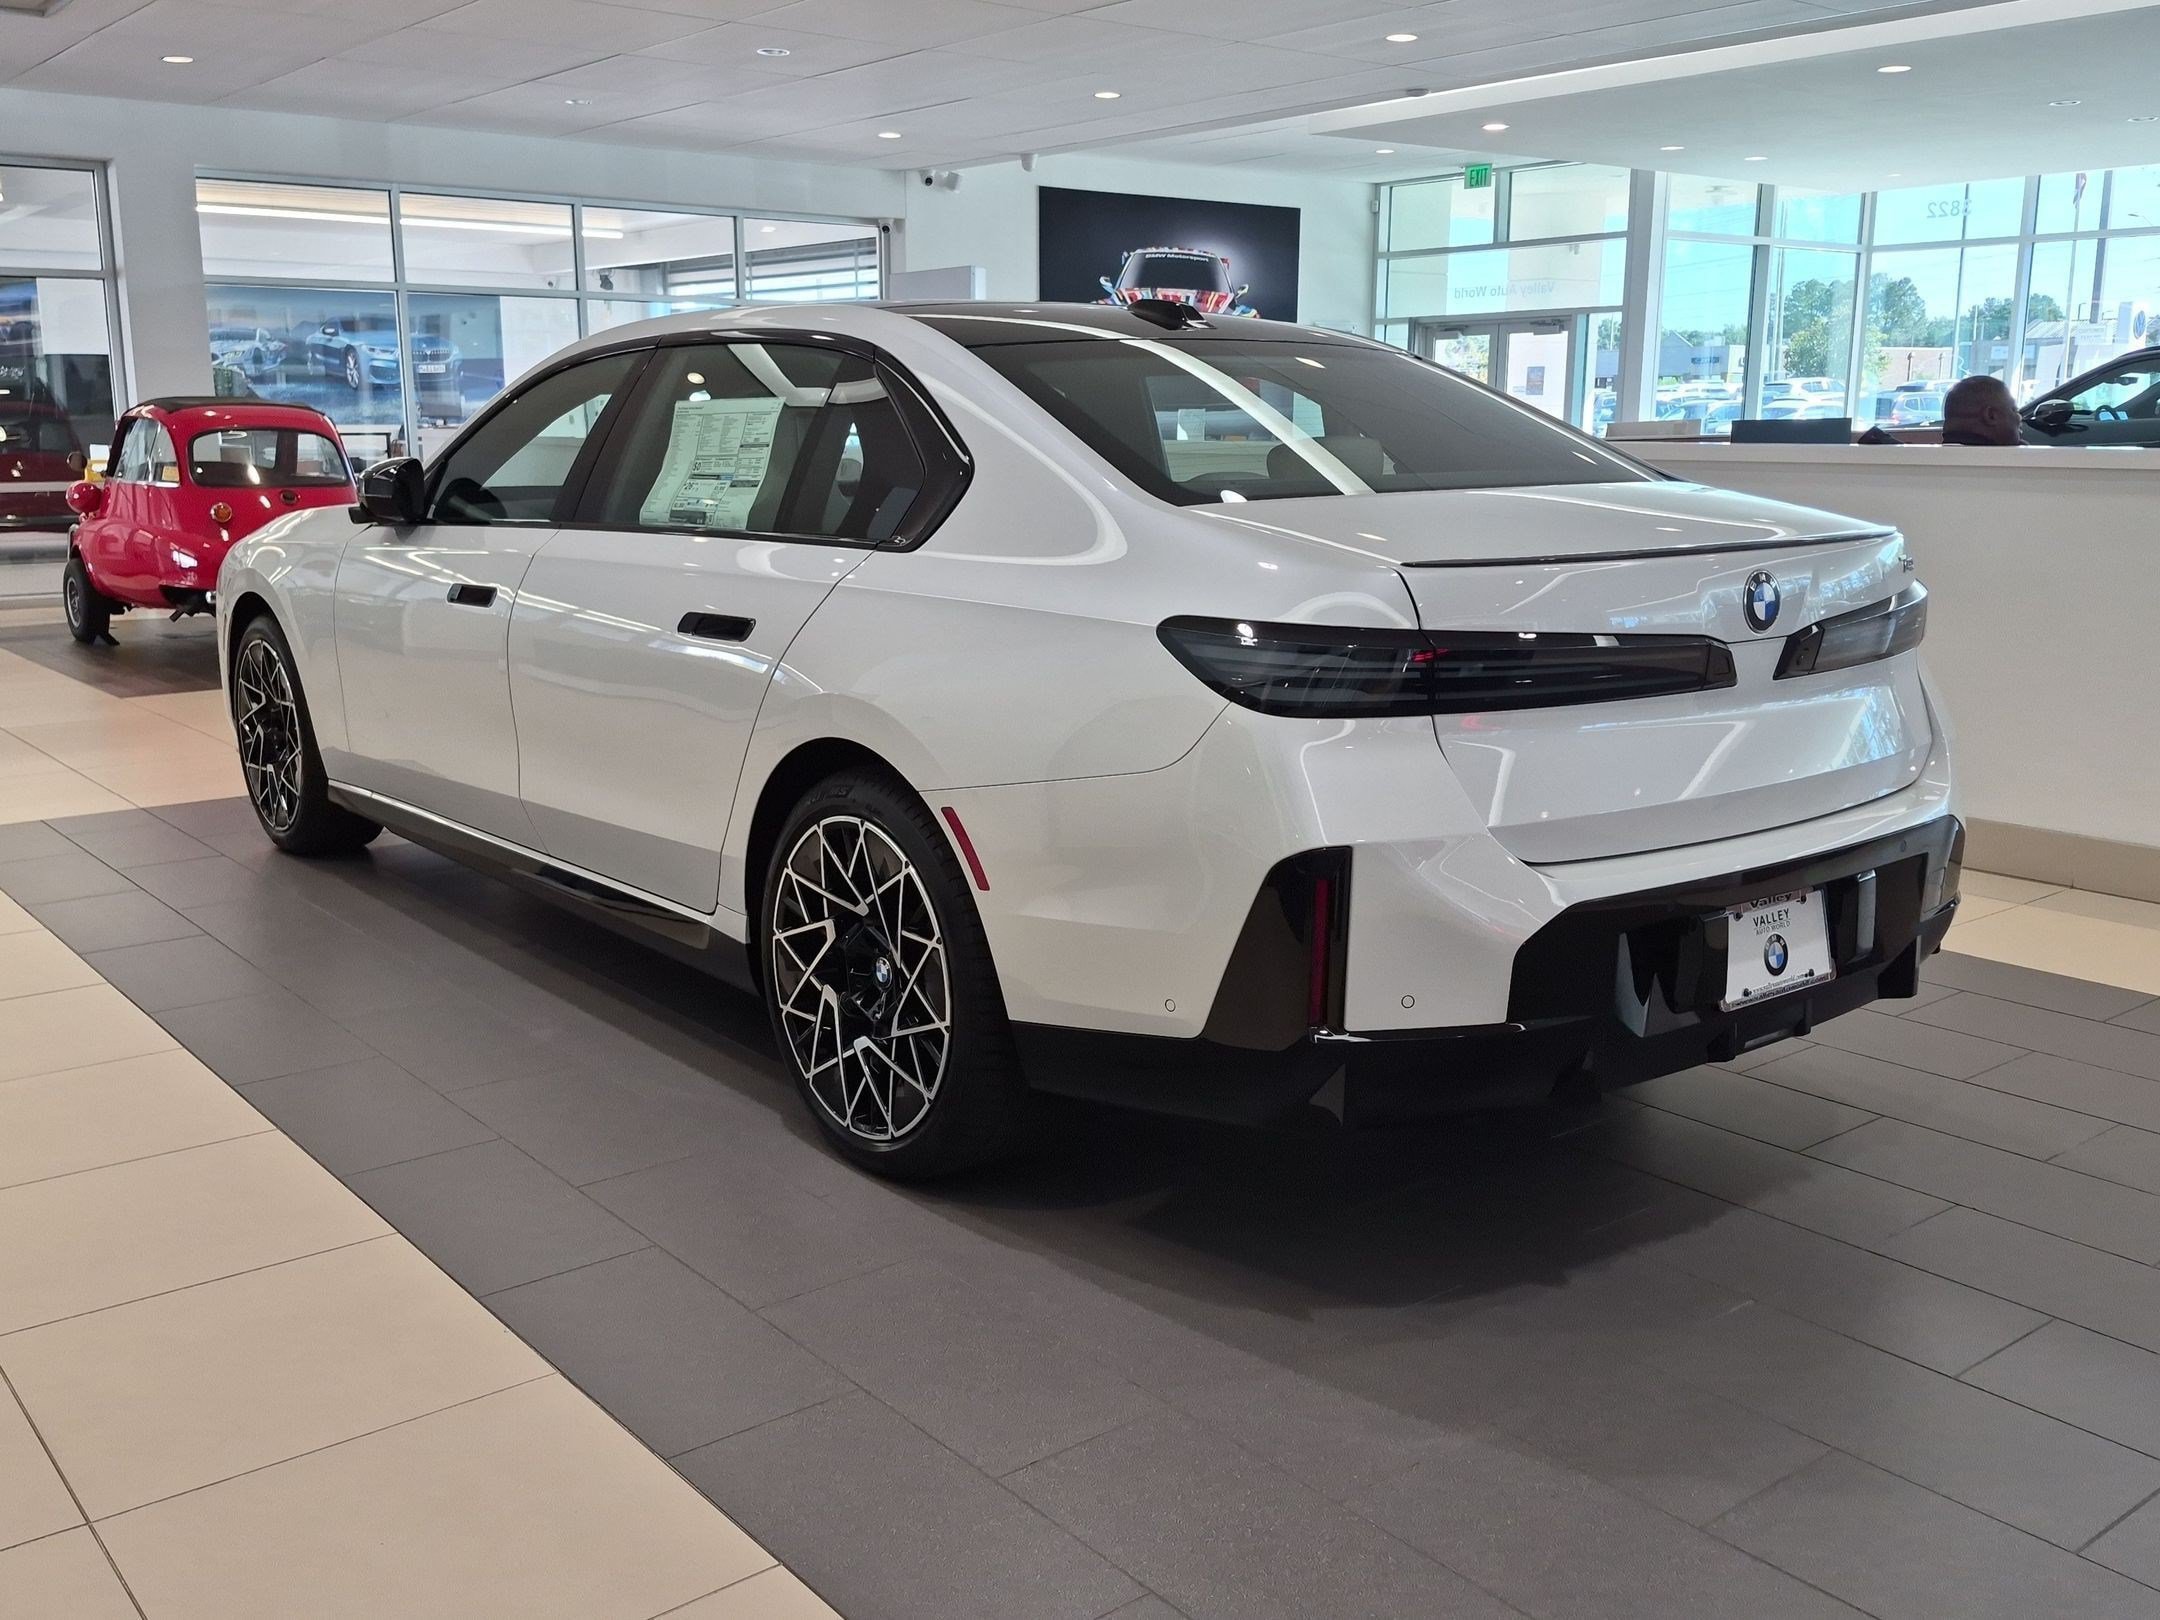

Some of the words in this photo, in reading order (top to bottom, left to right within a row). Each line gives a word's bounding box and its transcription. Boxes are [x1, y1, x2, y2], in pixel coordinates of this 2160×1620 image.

[1469, 168, 1488, 188] EXIT
[1167, 254, 1209, 262] Motorsport
[1750, 573, 1776, 591] BMW
[1750, 893, 1792, 908] Valley
[1753, 908, 1789, 927] VALLEY
[1755, 926, 1771, 935] AUTO
[1771, 920, 1791, 931] WORLD
